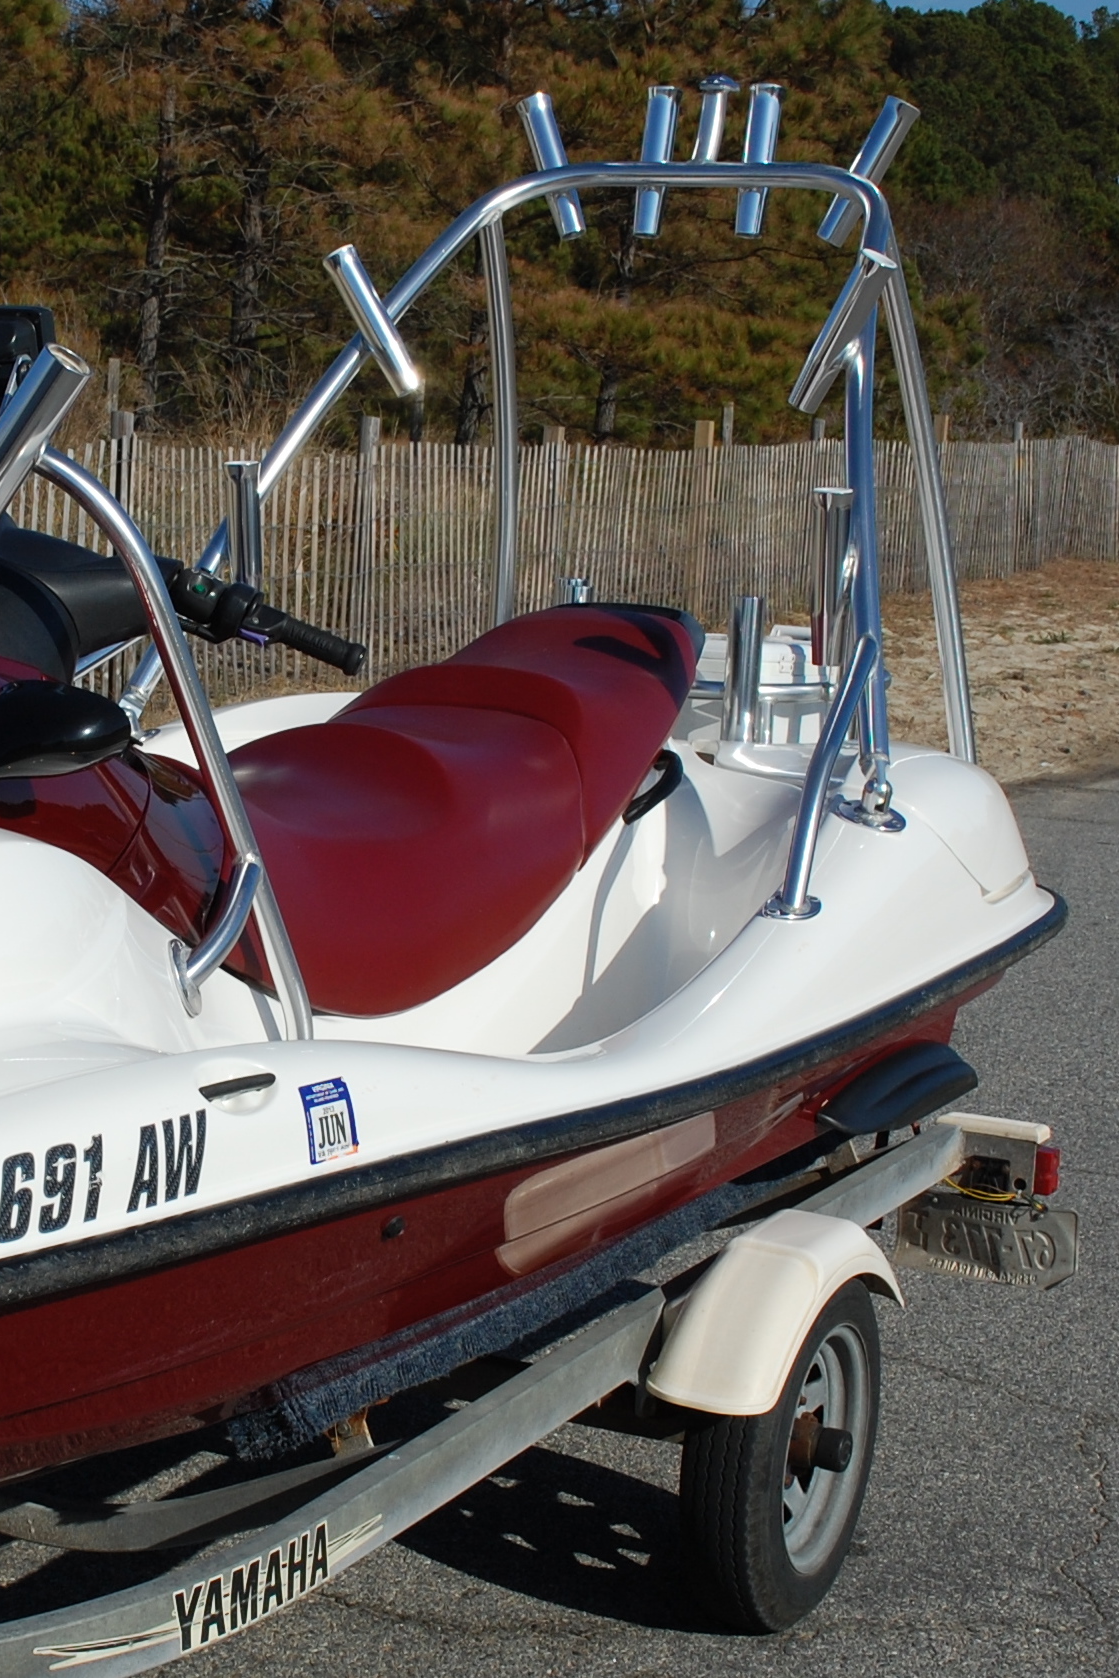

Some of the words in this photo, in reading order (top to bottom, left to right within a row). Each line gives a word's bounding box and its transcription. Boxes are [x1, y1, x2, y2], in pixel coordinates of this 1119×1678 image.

[126, 1108, 207, 1213] AW
[318, 1111, 347, 1149] JUN
[173, 1522, 330, 1652] YAMAHA
